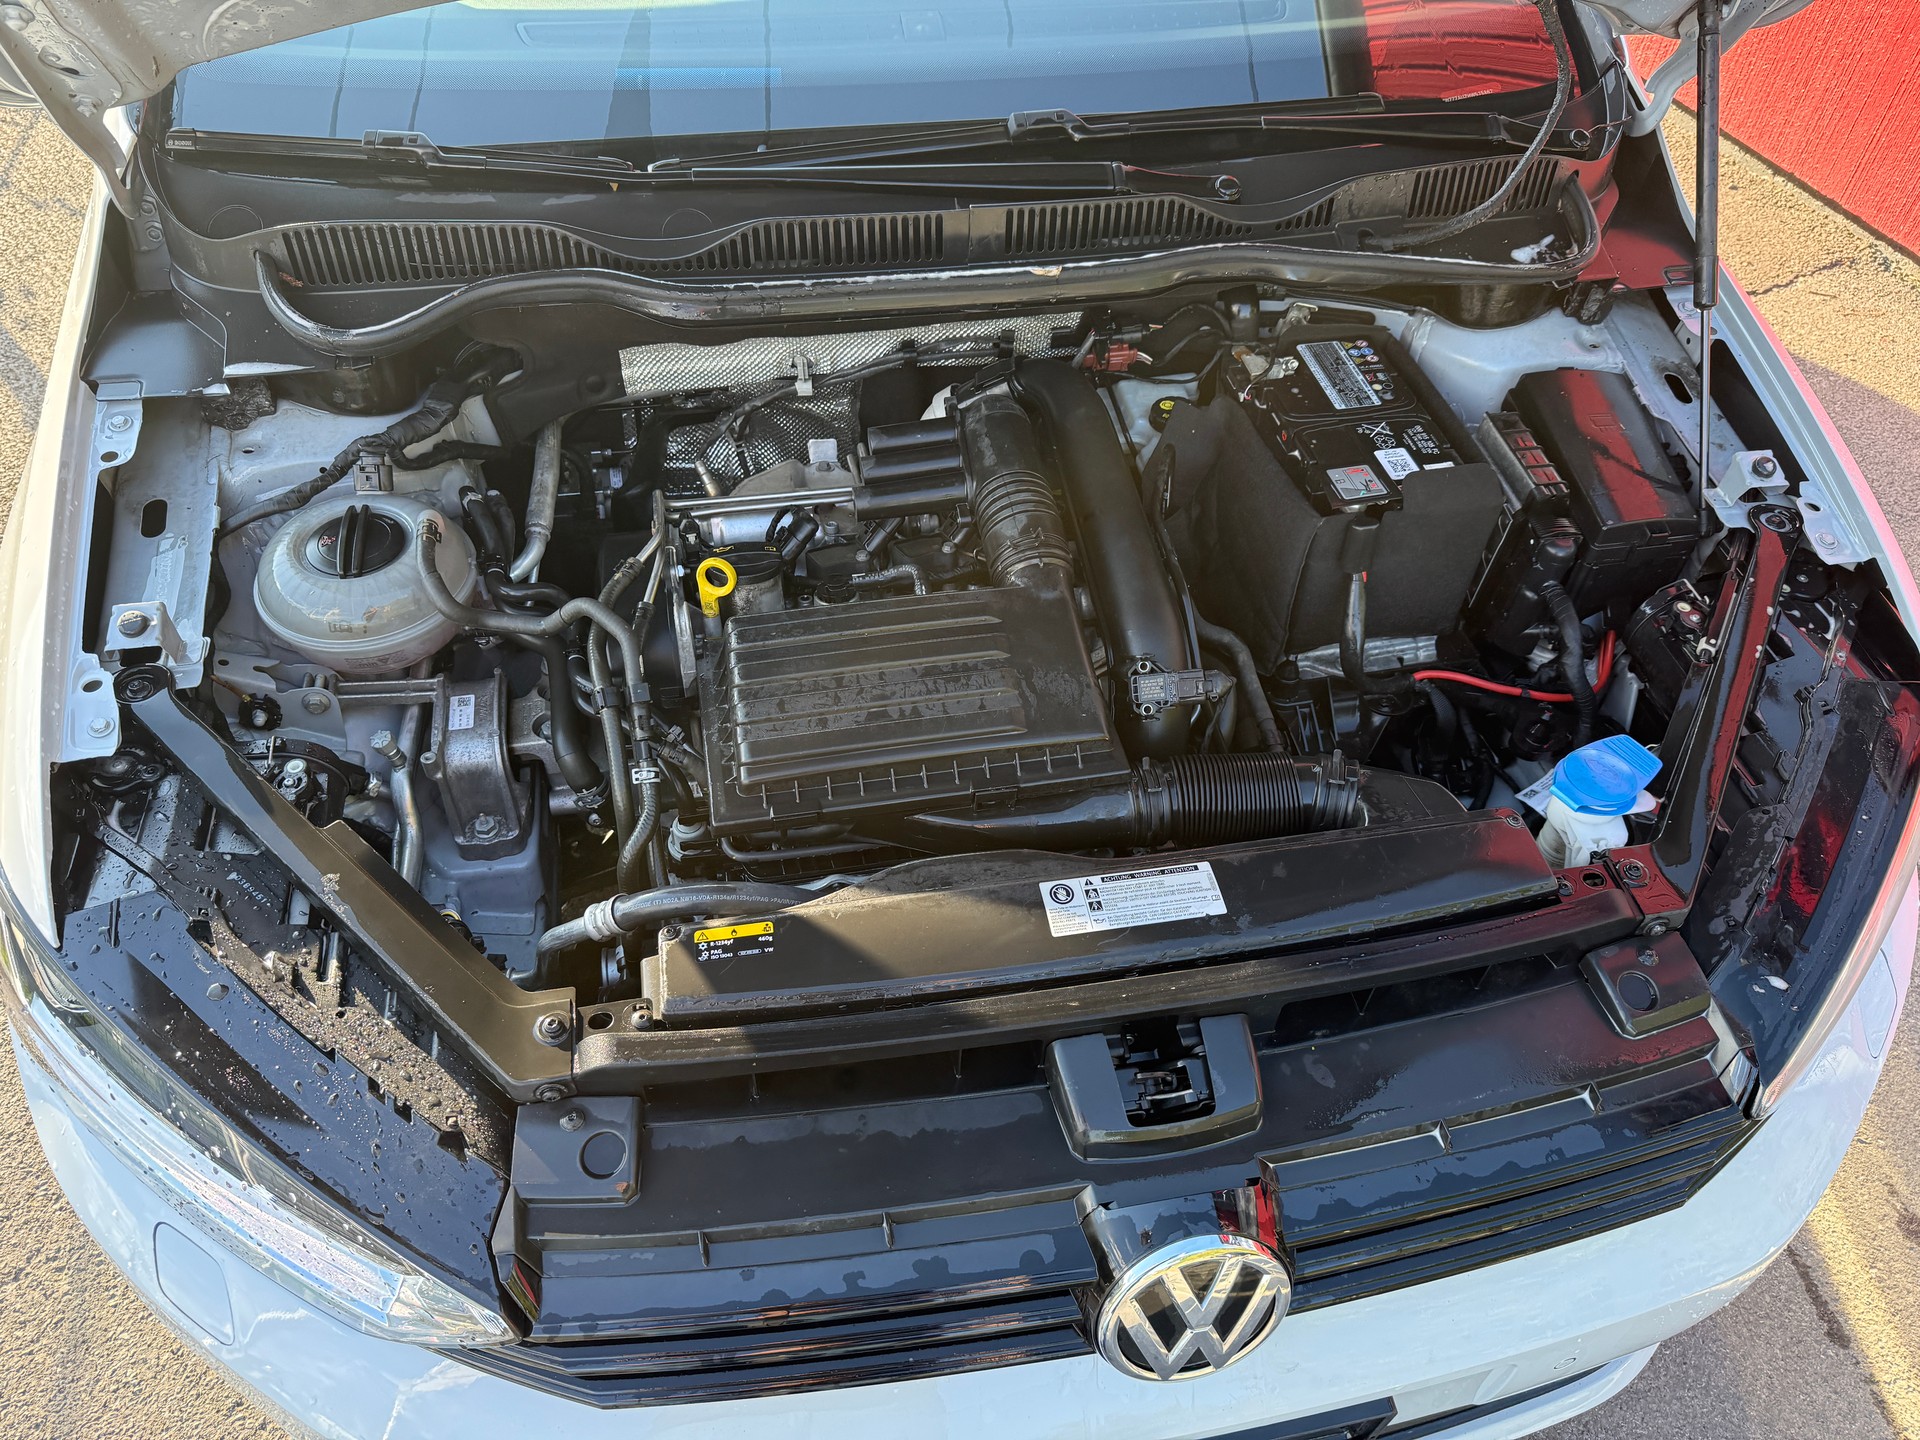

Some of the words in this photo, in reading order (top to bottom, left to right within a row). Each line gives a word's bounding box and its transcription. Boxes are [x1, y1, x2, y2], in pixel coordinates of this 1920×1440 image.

[1103, 874, 1131, 882] ACHTUNG
[1164, 866, 1195, 874] ATTENTION
[1112, 1250, 1291, 1382] VW
